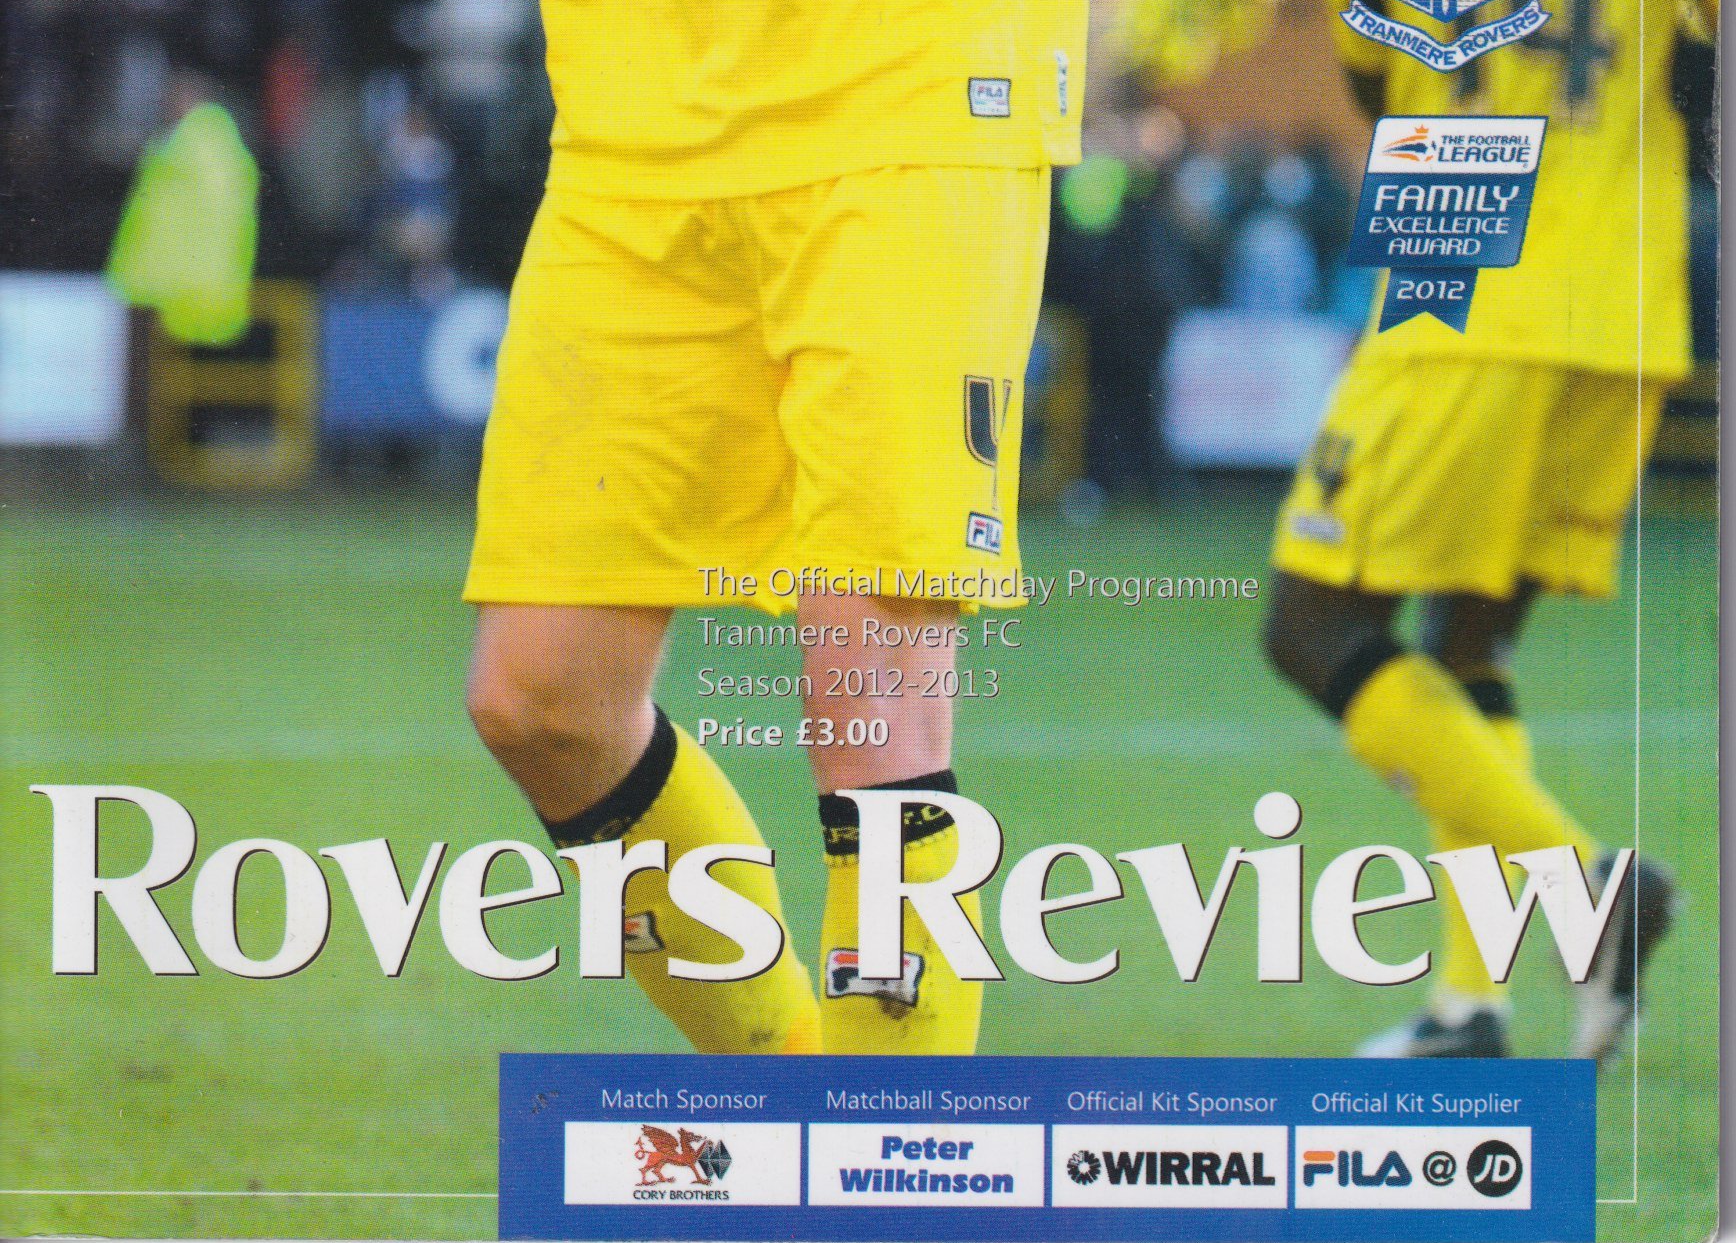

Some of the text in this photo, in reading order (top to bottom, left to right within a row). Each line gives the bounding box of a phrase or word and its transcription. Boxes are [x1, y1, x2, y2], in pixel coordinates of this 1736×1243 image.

[1349, 5, 1542, 66] TRANMERE ROVERS
[1441, 134, 1531, 146] THE FOOTBALL
[1438, 146, 1531, 163] LEAGUE
[1374, 185, 1520, 212] FAMILY
[1368, 216, 1511, 235] EXCELLENCE
[1388, 237, 1482, 256] AWARD
[1396, 280, 1466, 300] 2012
[698, 565, 1260, 607] The Official Matchday Programme
[698, 616, 1023, 648] Tranmere Rovers FC
[697, 667, 1001, 698] Season 2012-2013
[697, 716, 891, 747] Price £3.00
[29, 783, 1636, 987] Rovers Review
[601, 1089, 768, 1116] Match Sponsor
[826, 1089, 1031, 1117] Matchball Sponsor
[1067, 1090, 1278, 1116] Official Kit Sponsor
[1312, 1091, 1522, 1117] Official Kit Supplier
[881, 1135, 974, 1160] Peter
[840, 1167, 1014, 1193] Wilkinson
[1103, 1152, 1276, 1186] WIRRAL
[1303, 1150, 1413, 1187] FILA
[1422, 1150, 1458, 1187] @
[633, 1190, 730, 1201] CORY BROTHERS
